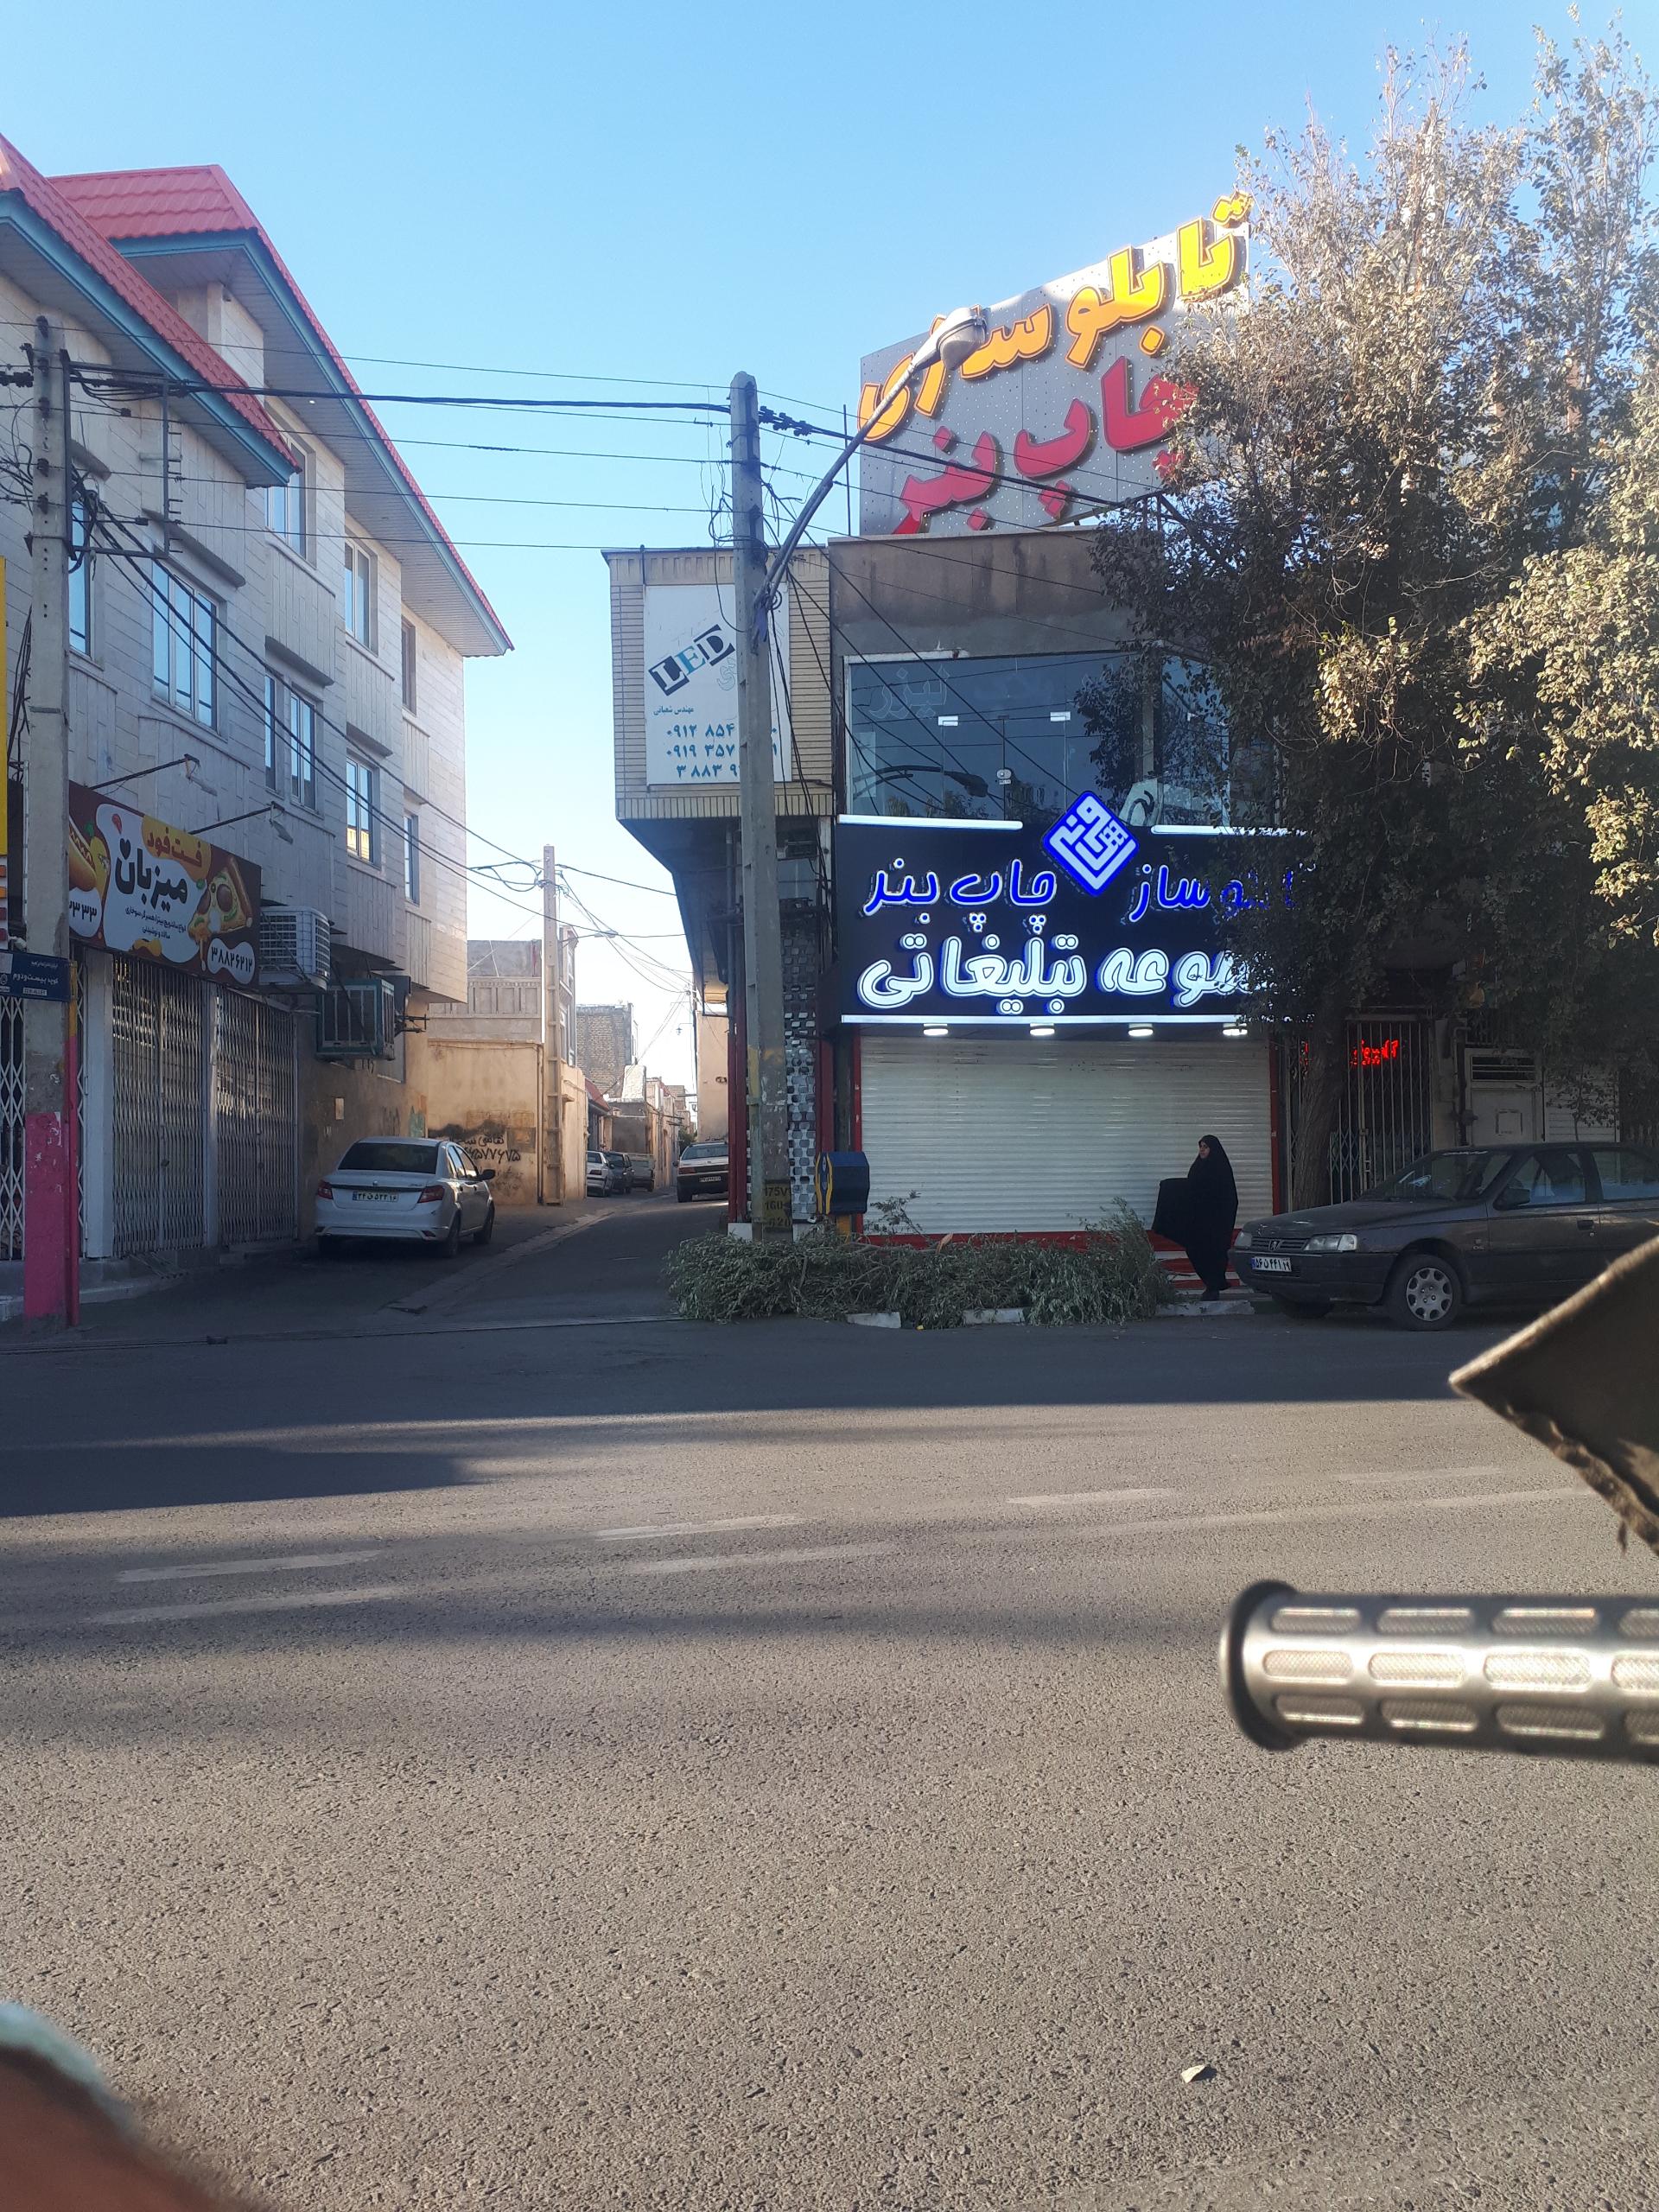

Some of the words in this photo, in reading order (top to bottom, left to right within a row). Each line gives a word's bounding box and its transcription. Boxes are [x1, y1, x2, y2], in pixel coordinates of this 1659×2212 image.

[892, 425, 996, 534] بنر
[648, 624, 735, 696] LED
[674, 705, 695, 715] مهندس
[666, 744, 697, 758] ۰۹۱۹
[115, 838, 188, 912] میزبان
[147, 826, 171, 857] فود
[171, 838, 202, 868] فست
[862, 858, 940, 925] بنر
[950, 858, 1057, 934] چاپ
[1128, 864, 1210, 923] ساز
[858, 933, 1088, 1014] تبلیغاتی
